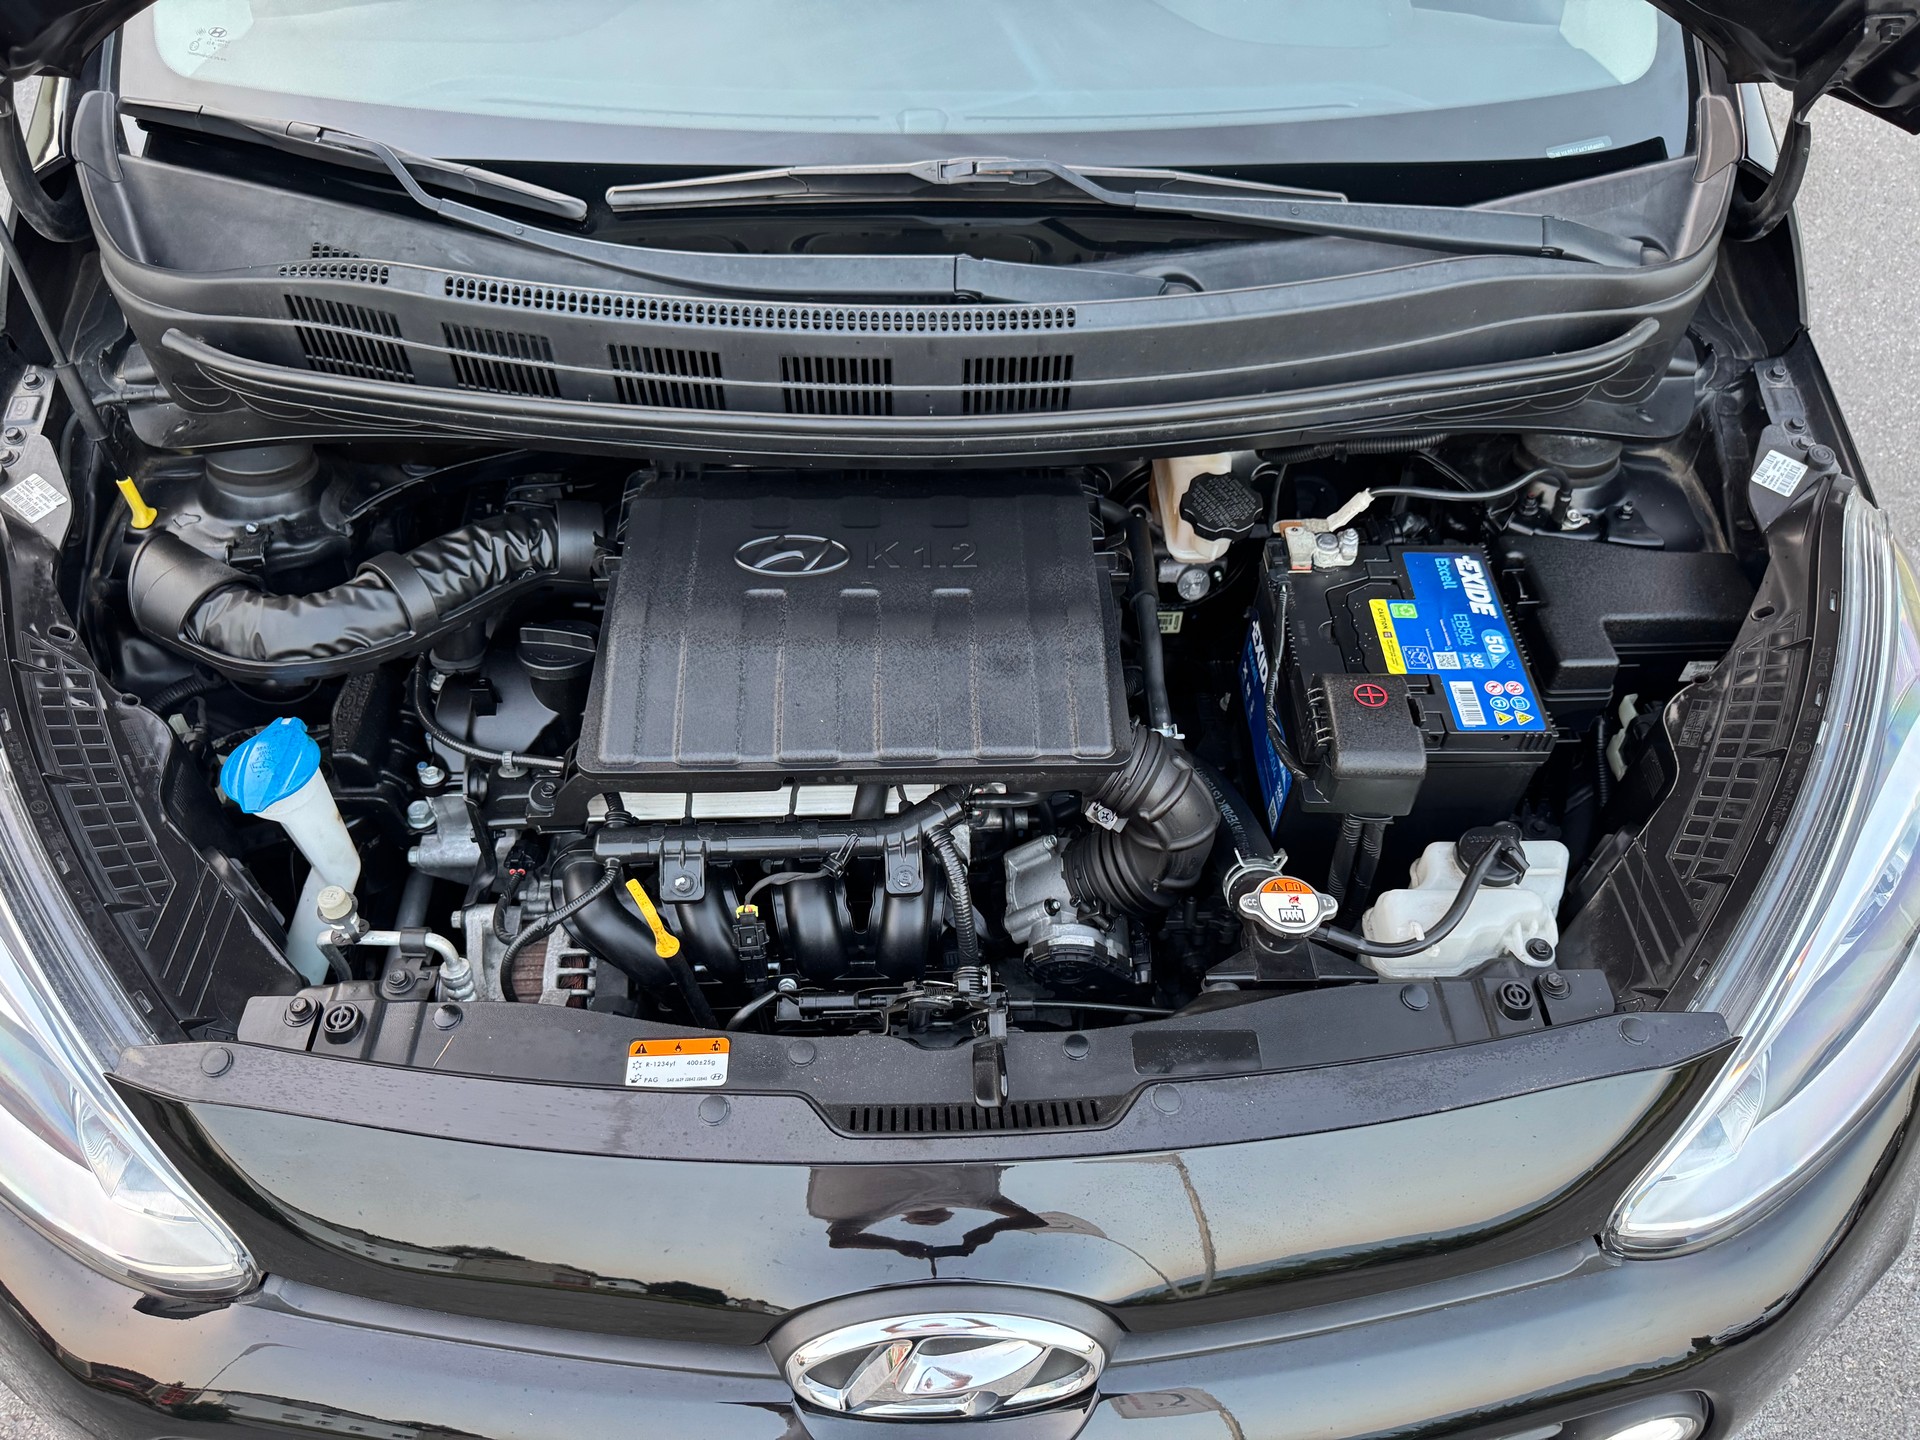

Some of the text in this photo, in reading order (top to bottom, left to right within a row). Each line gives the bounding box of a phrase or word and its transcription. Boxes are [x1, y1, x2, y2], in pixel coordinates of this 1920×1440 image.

[1435, 557, 1458, 590] Excell
[1454, 555, 1498, 617] EXIDE
[1377, 607, 1389, 630] CAUTION
[1453, 613, 1478, 647] EB504
[1252, 620, 1269, 695] EXID
[1484, 635, 1506, 654] 50
[1470, 653, 1485, 668] 360
[1506, 659, 1517, 670] 12V
